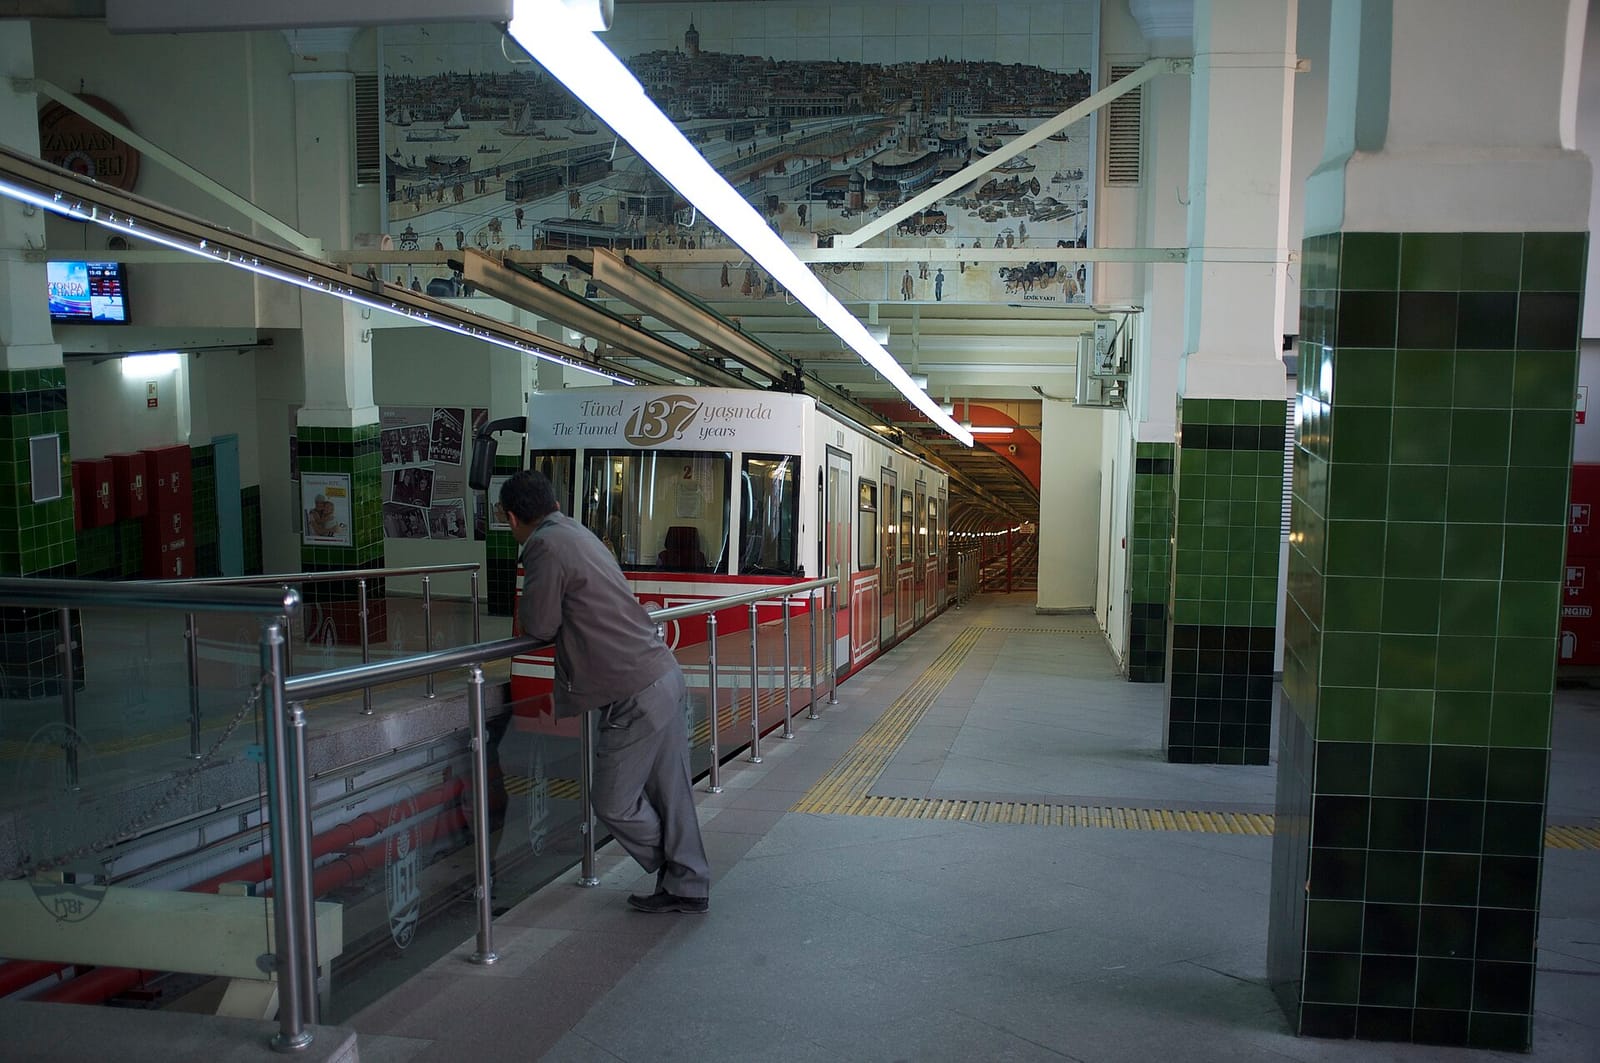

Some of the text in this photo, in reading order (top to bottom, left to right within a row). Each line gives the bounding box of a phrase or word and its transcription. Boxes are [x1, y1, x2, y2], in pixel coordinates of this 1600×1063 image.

[579, 400, 772, 440] Tünel 137 yaşında
[552, 422, 736, 440] The Tunnel years
[683, 464, 692, 479] 2
